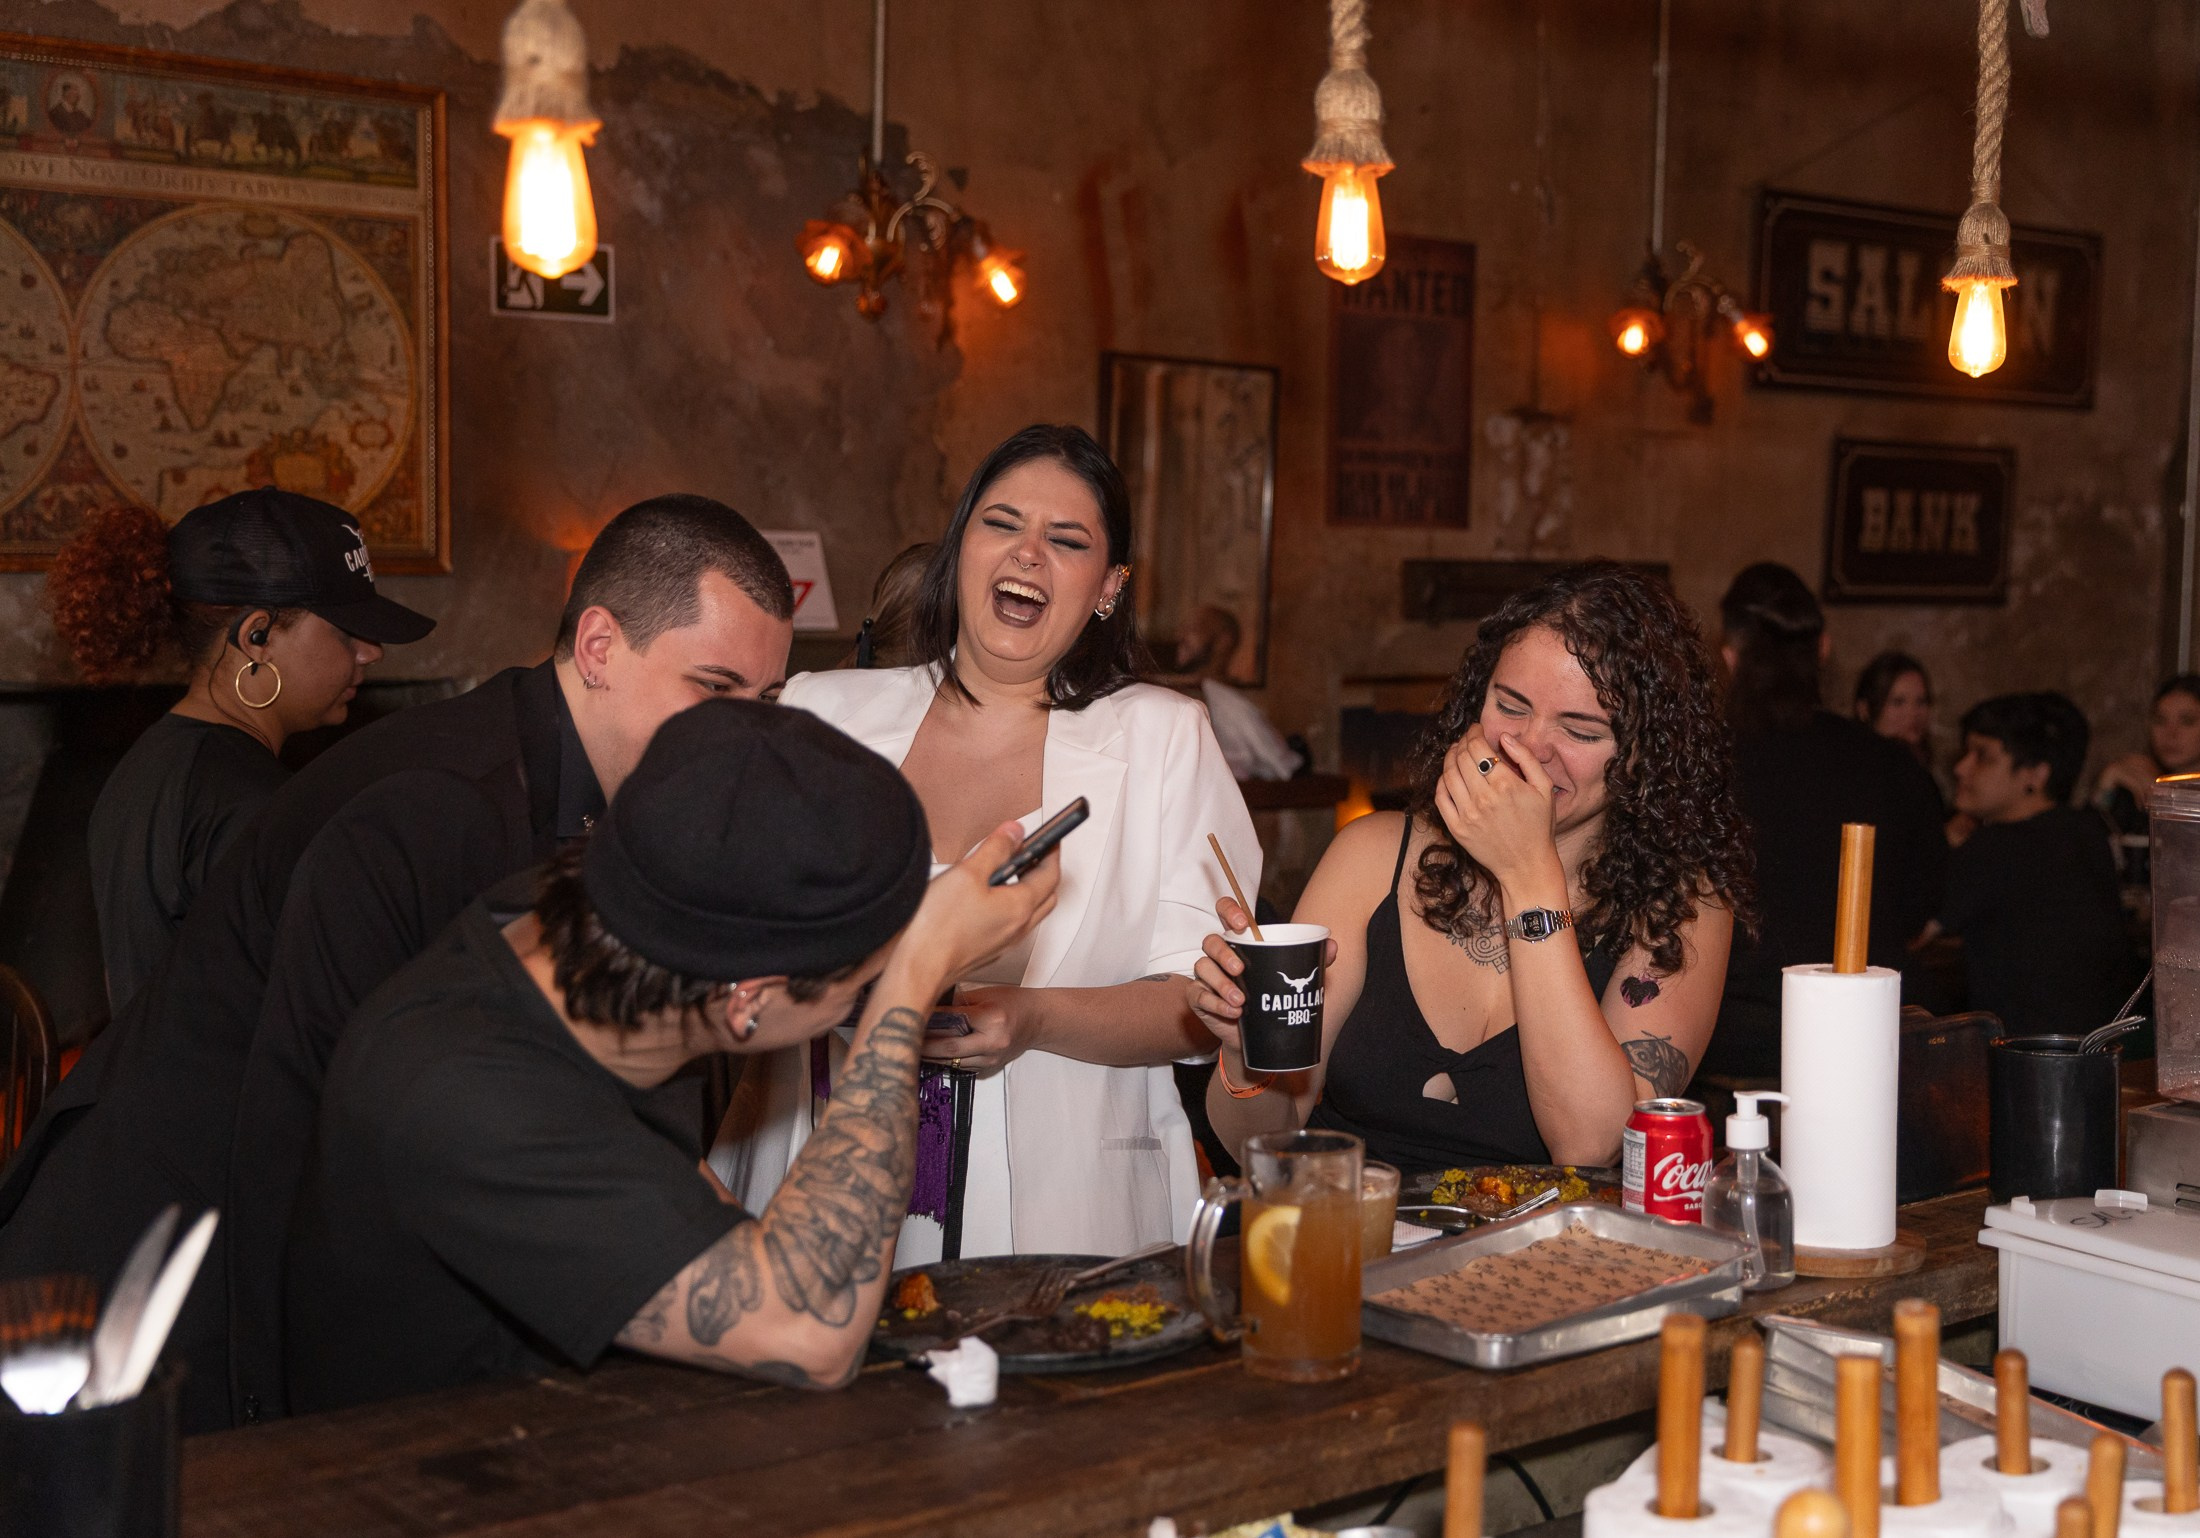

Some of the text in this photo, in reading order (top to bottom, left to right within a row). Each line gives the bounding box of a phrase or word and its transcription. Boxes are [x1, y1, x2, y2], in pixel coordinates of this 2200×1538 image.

[1804, 238, 2061, 350] SALN
[1860, 488, 1981, 554] BANK
[1287, 1008, 1311, 1026] BBQ
